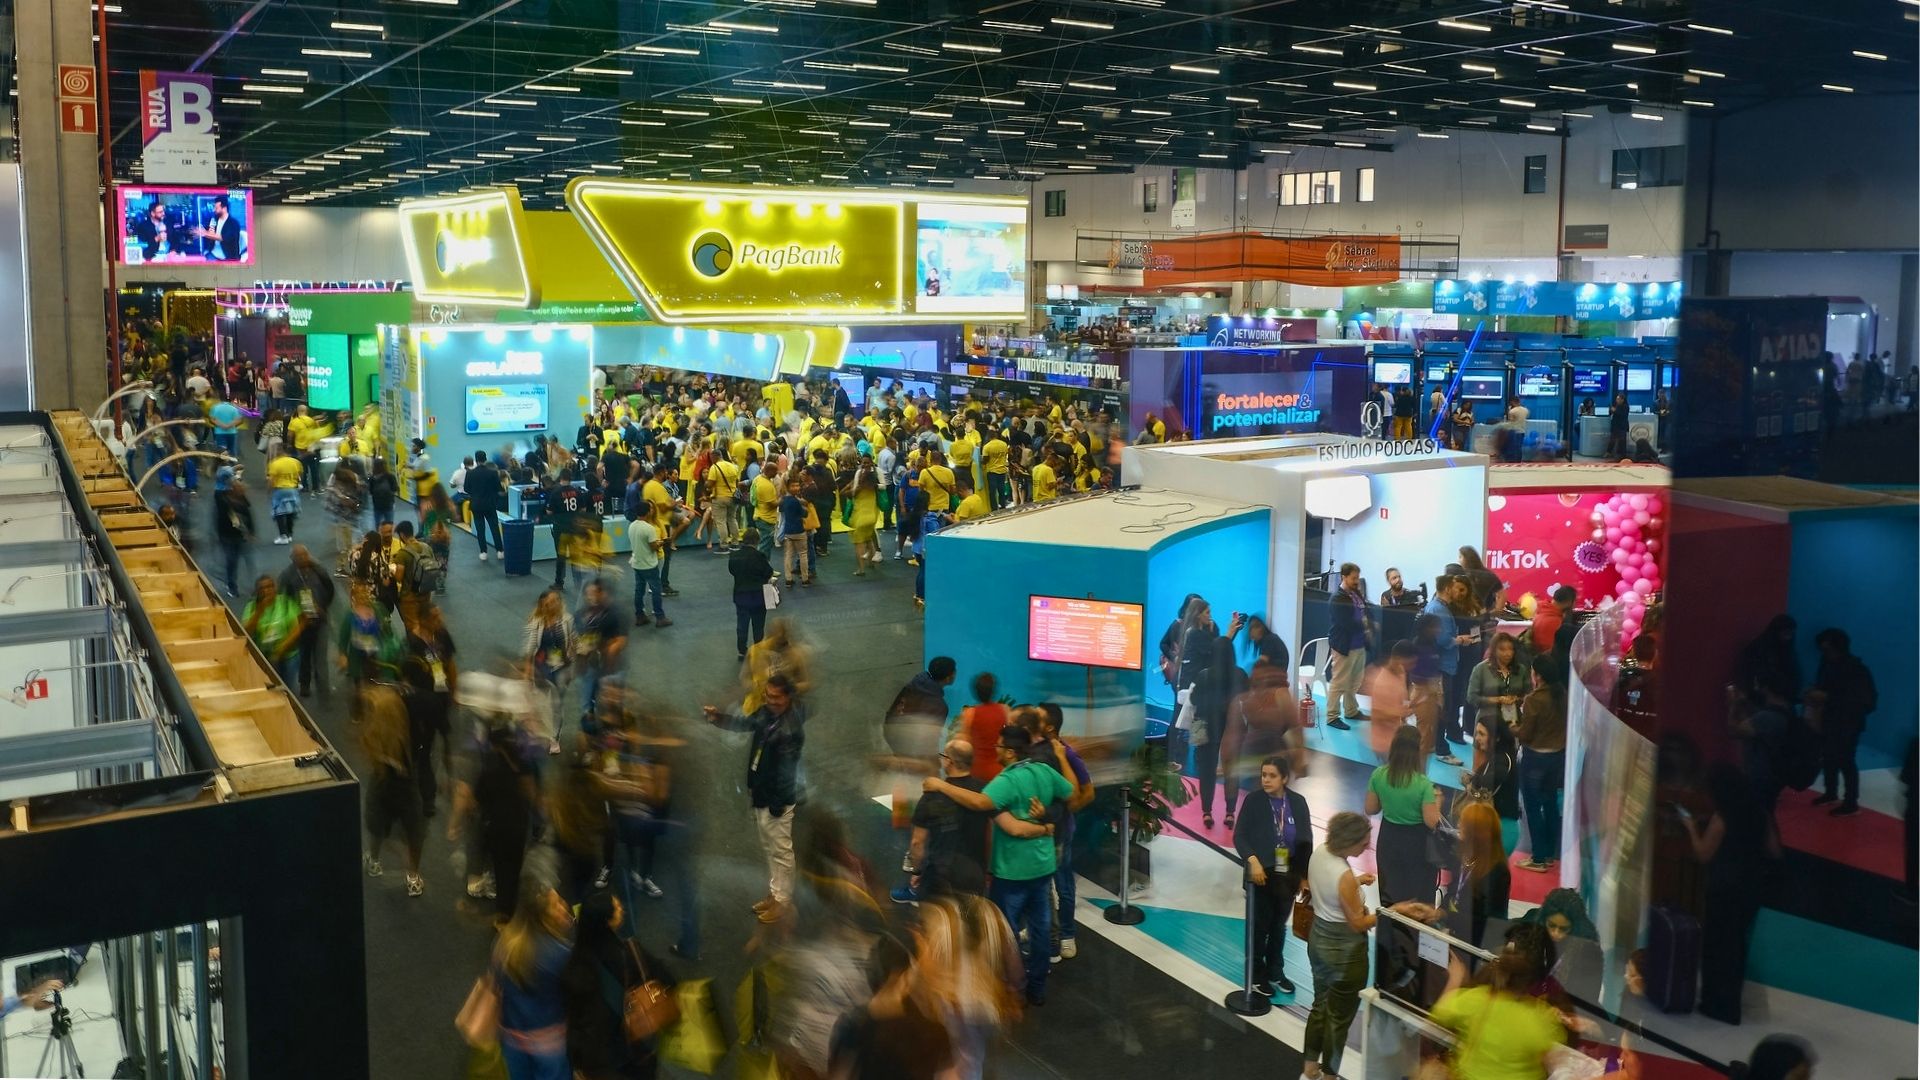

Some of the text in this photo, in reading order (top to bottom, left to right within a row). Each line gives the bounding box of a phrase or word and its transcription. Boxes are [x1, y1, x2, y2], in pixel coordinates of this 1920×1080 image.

[148, 87, 167, 128] RUA
[169, 81, 214, 134] B
[1124, 243, 1152, 254] Sebrae
[1344, 245, 1377, 256] Sebrae
[741, 244, 842, 271] PagBank
[1124, 255, 1136, 265] for
[1344, 258, 1357, 268] for
[1233, 327, 1281, 341] NETWORKING
[1017, 358, 1121, 380] INNOVATION SUPER BOWL
[1213, 408, 1321, 432] potencializar
[1319, 438, 1441, 461] ESTÚDIO PODCAST
[564, 497, 577, 512] 18
[593, 501, 604, 515] 18
[1582, 550, 1603, 564] YES
